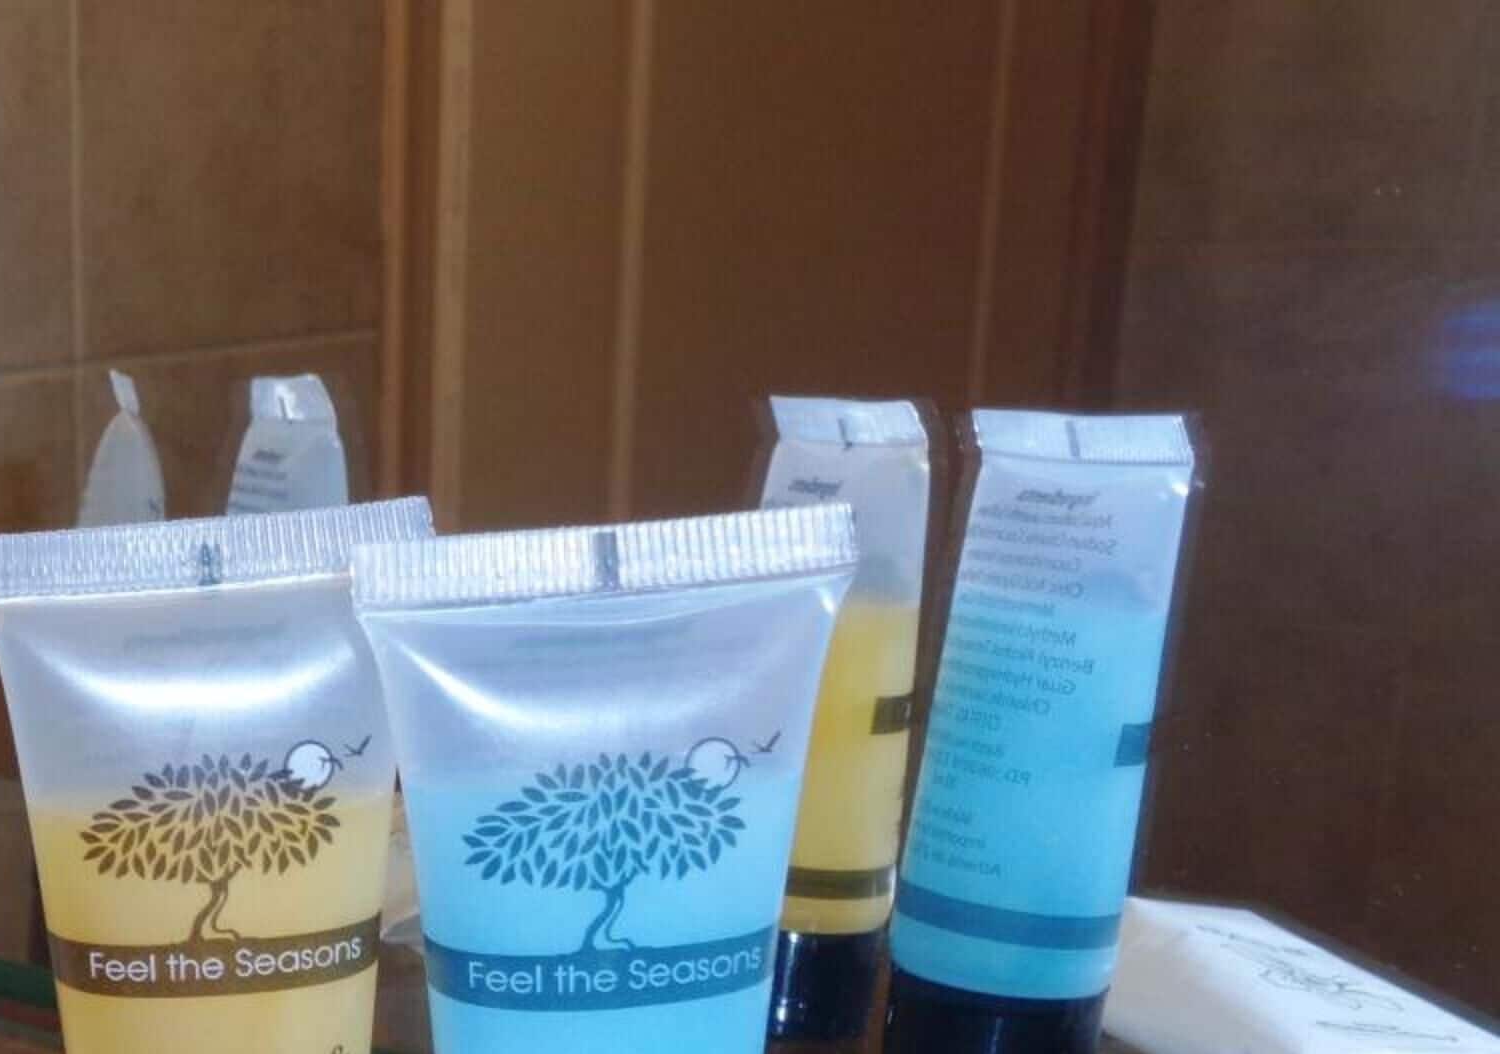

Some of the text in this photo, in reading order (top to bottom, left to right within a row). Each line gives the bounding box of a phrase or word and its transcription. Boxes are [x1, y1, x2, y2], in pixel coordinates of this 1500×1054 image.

[89, 937, 362, 983] Feel the Seasons
[467, 946, 762, 994] Feel the Seasons
